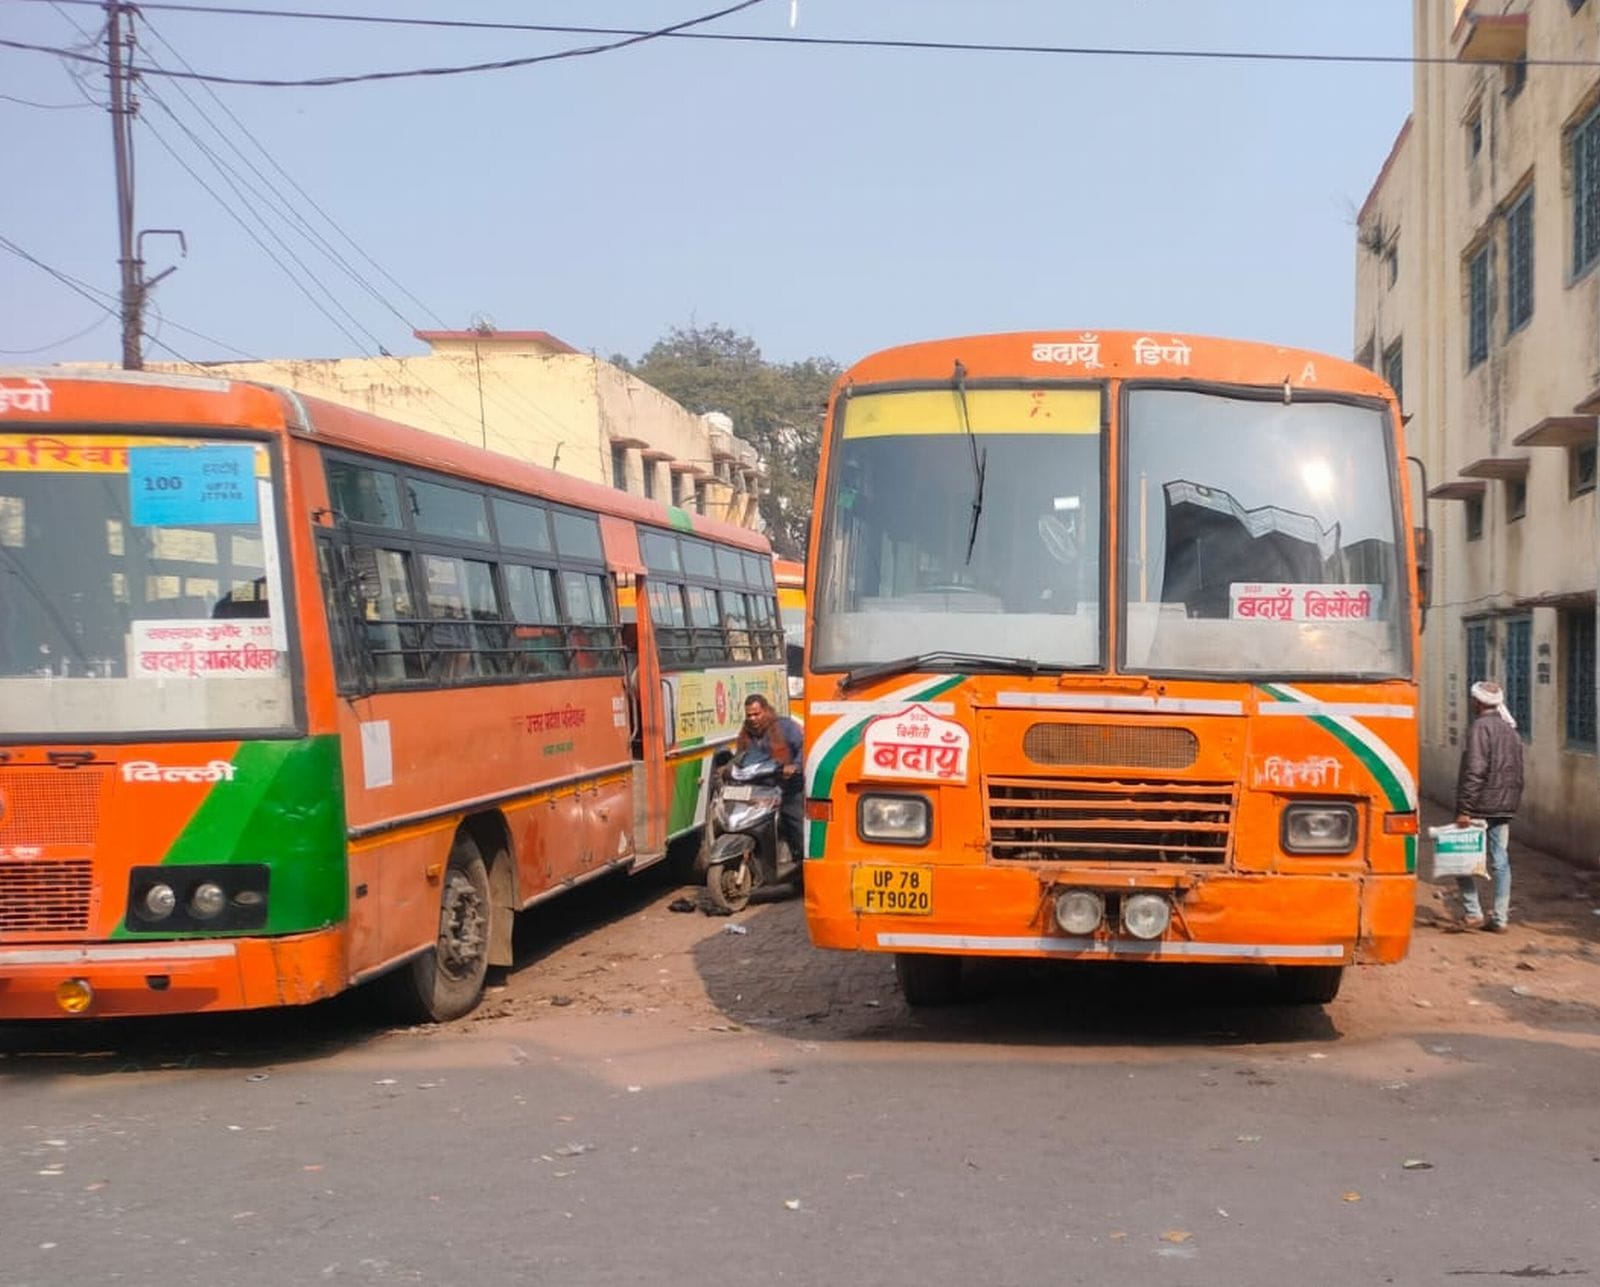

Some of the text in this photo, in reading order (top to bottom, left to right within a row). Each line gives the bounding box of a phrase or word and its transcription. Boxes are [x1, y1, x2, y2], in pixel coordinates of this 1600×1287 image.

[1031, 333, 1193, 368] बदायूँ डिपो
[1301, 361, 1317, 383] A
[144, 476, 183, 491] 100
[1237, 587, 1294, 620] बदायूँ
[872, 731, 965, 778] बदायूँ
[122, 760, 238, 782] दिल्ली
[874, 870, 919, 889] UP 78
[866, 890, 928, 910] FT9020
